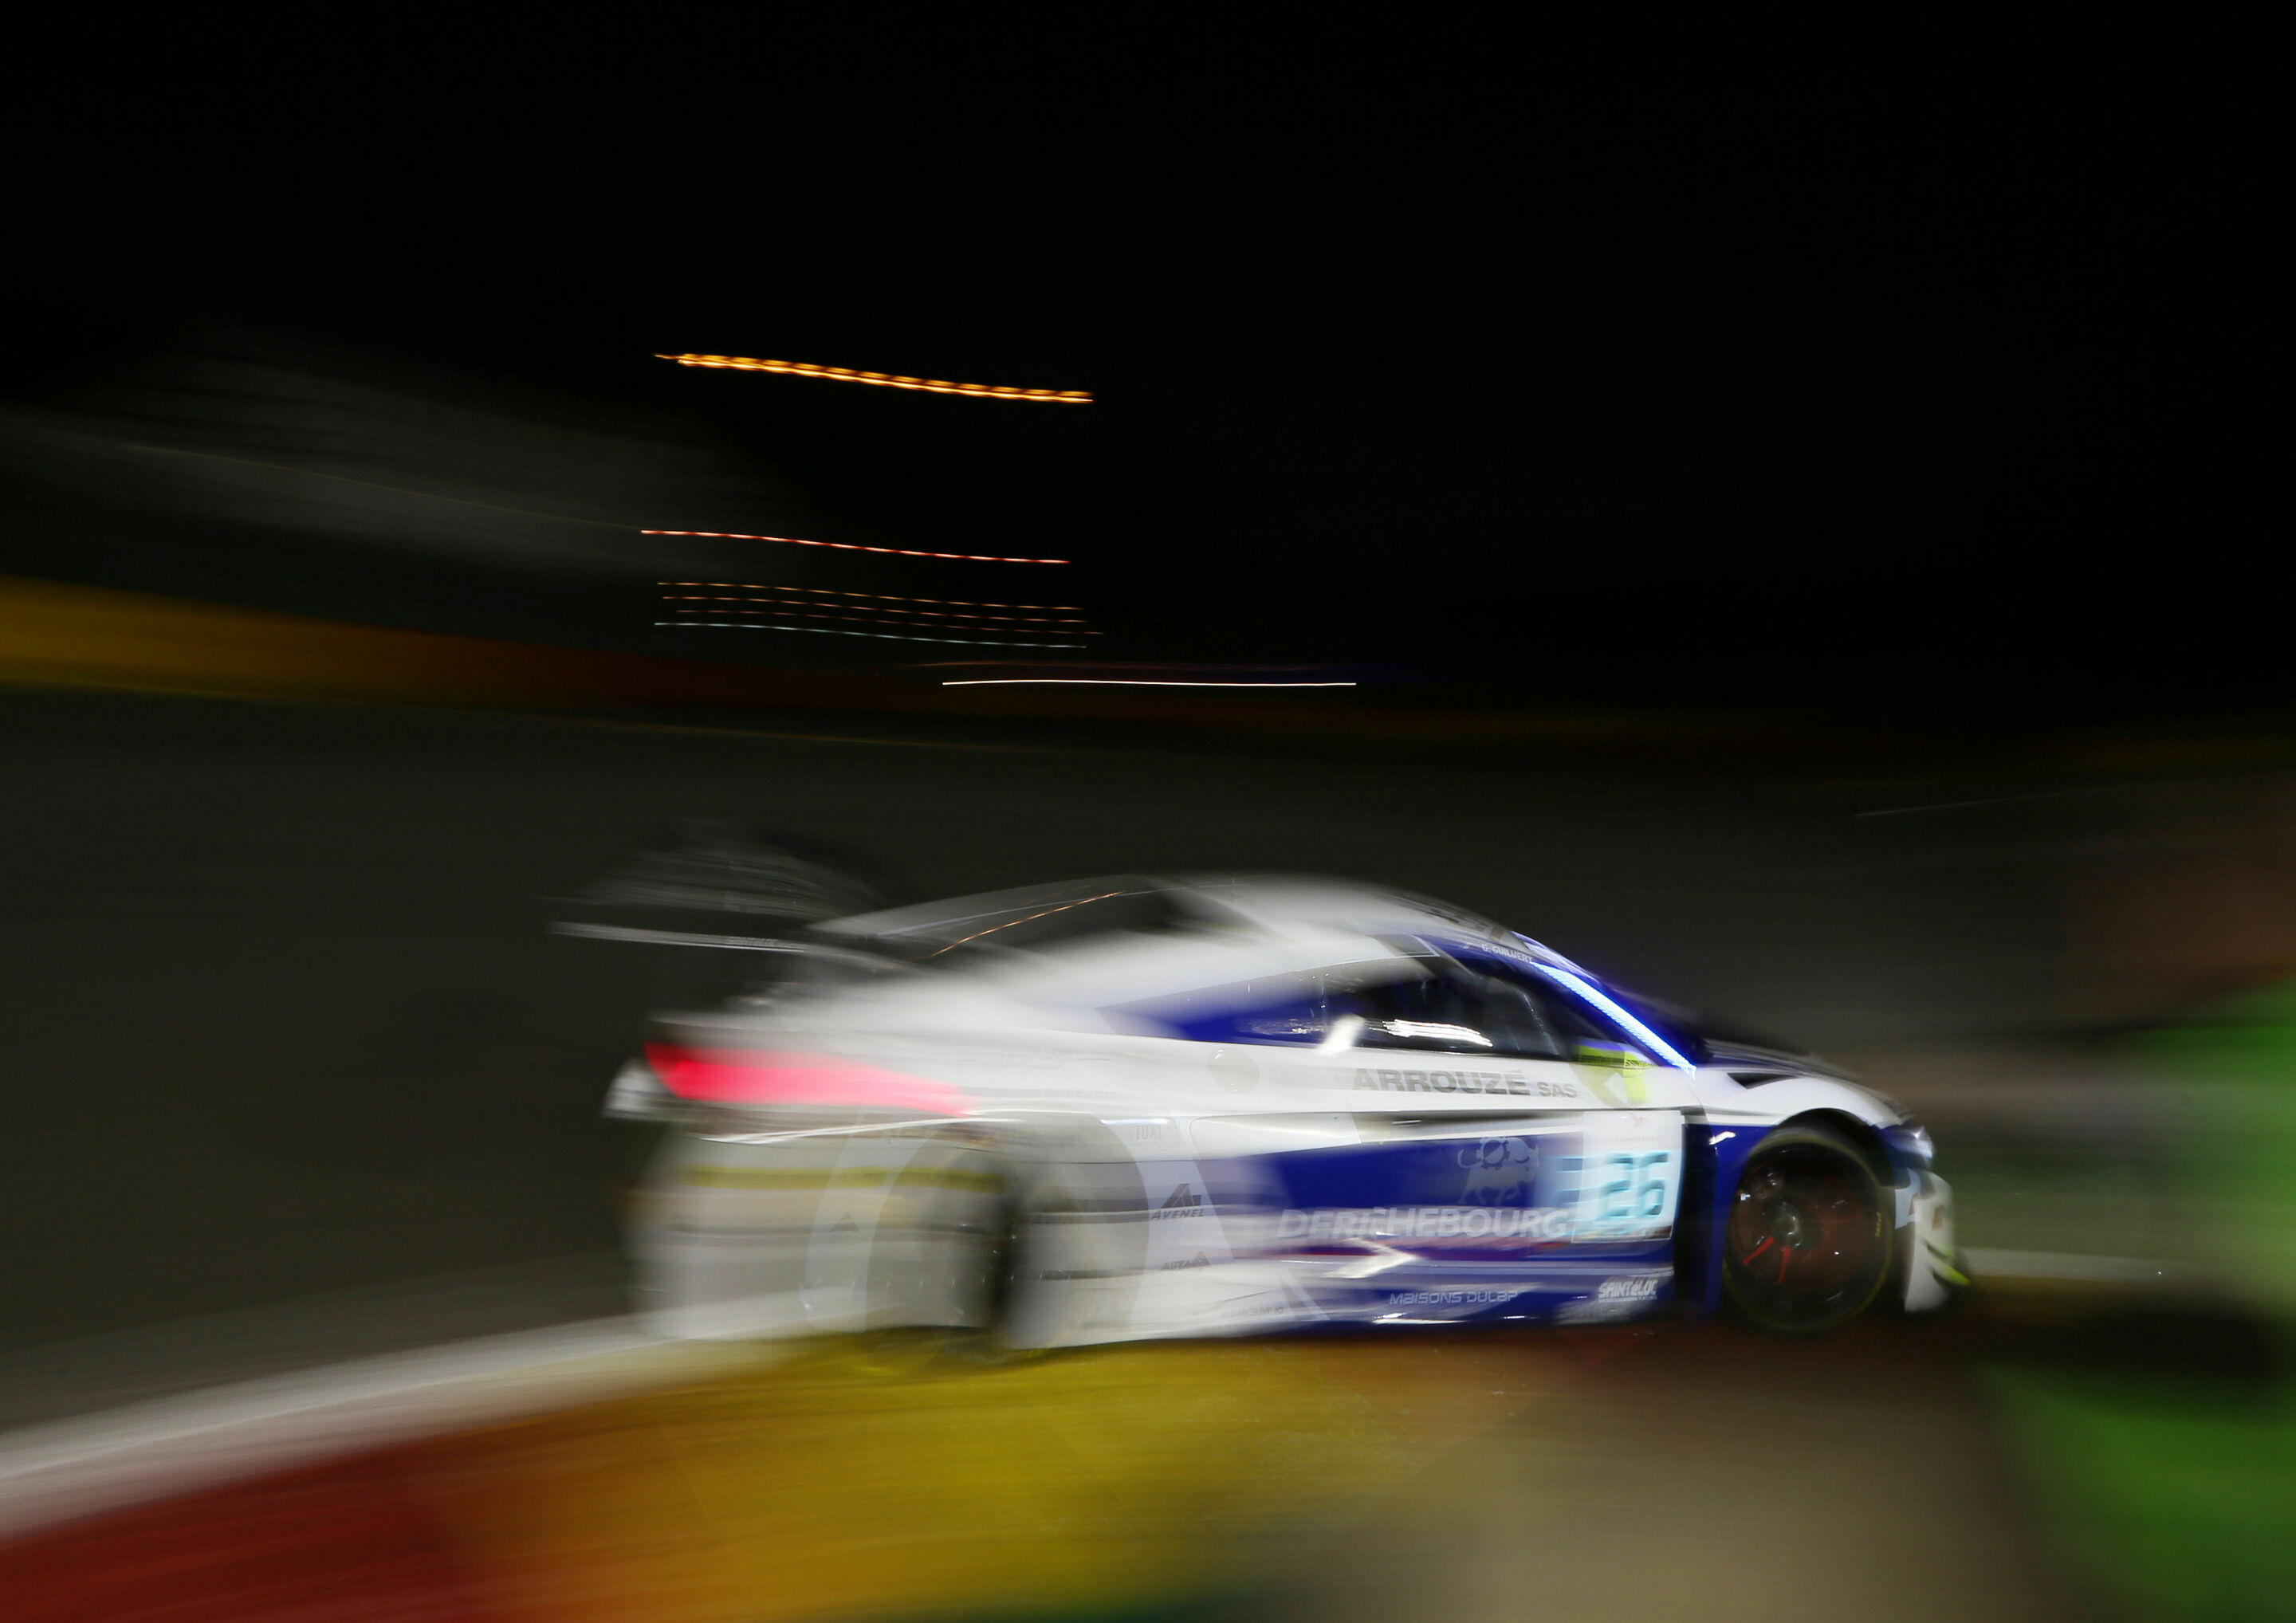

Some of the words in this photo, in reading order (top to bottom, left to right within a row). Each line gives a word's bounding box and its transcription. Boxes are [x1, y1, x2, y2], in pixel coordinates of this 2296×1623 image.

[1537, 1081, 1578, 1098] SAS
[1596, 1150, 1669, 1220] 26
[1150, 1208, 1205, 1220] AVENEL
